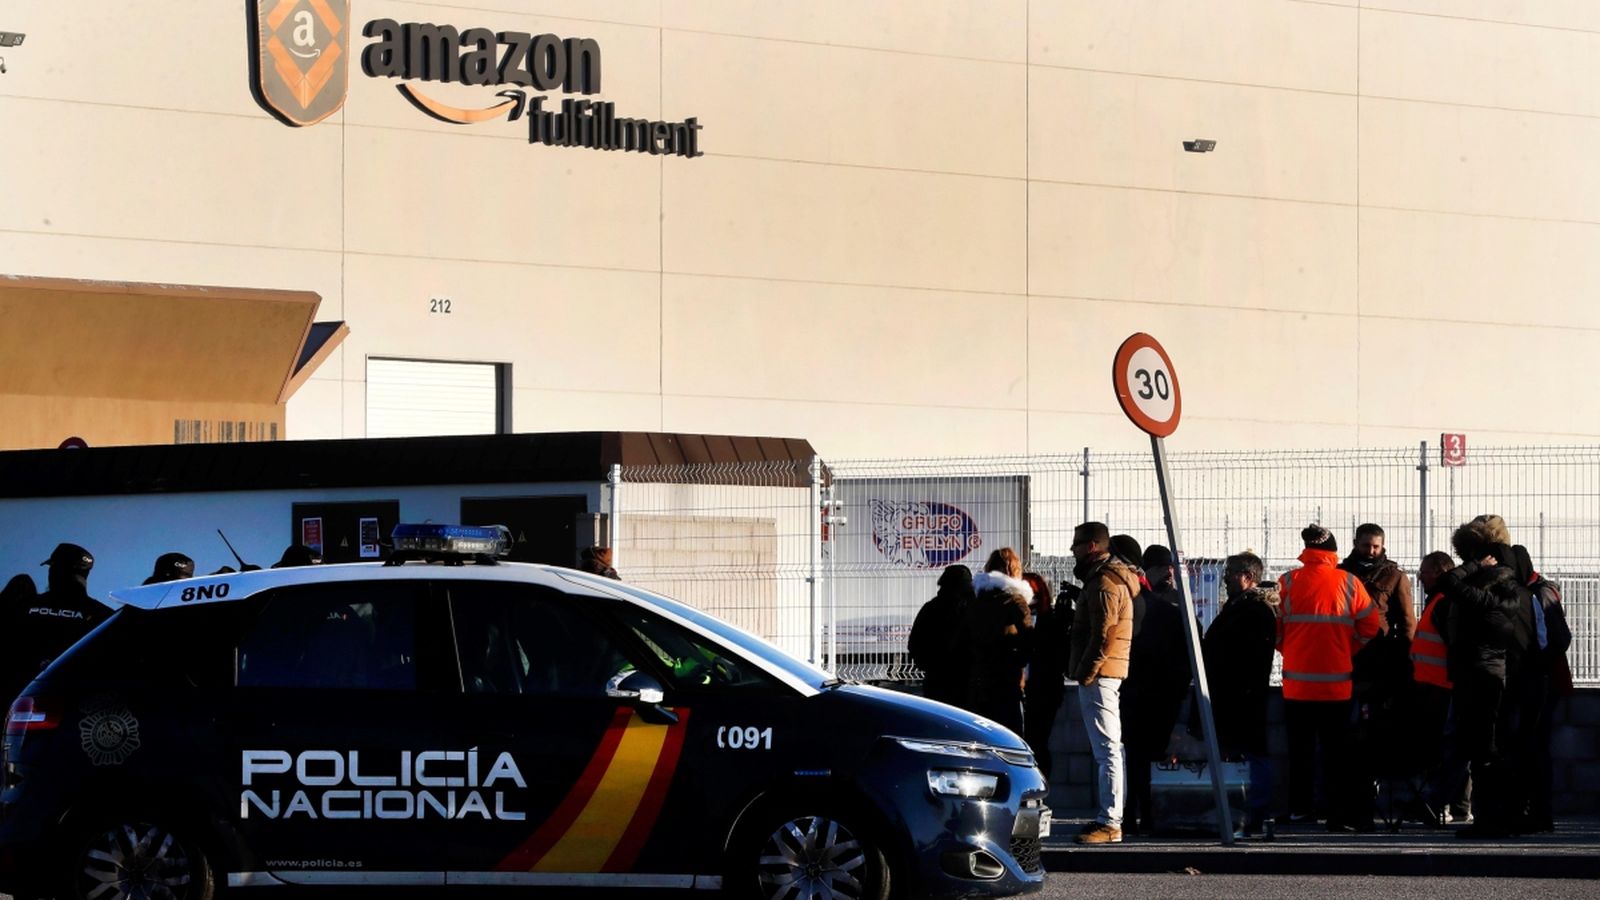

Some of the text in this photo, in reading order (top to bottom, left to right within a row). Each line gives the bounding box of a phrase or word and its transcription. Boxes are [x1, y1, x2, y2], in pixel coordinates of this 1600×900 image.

[293, 10, 315, 47] a
[361, 18, 600, 95] amazon
[526, 95, 704, 158] fulfillment
[430, 298, 451, 313] 212
[1134, 368, 1169, 401] 30
[1450, 436, 1461, 457] 3
[902, 515, 962, 530] GRUPO
[902, 535, 963, 550] EVELYN
[28, 607, 84, 620] POLICIA
[727, 726, 773, 750] 091
[242, 746, 527, 788] POLICÍA
[240, 790, 526, 821] NACIONAL
[265, 859, 363, 868] www.policia.es
